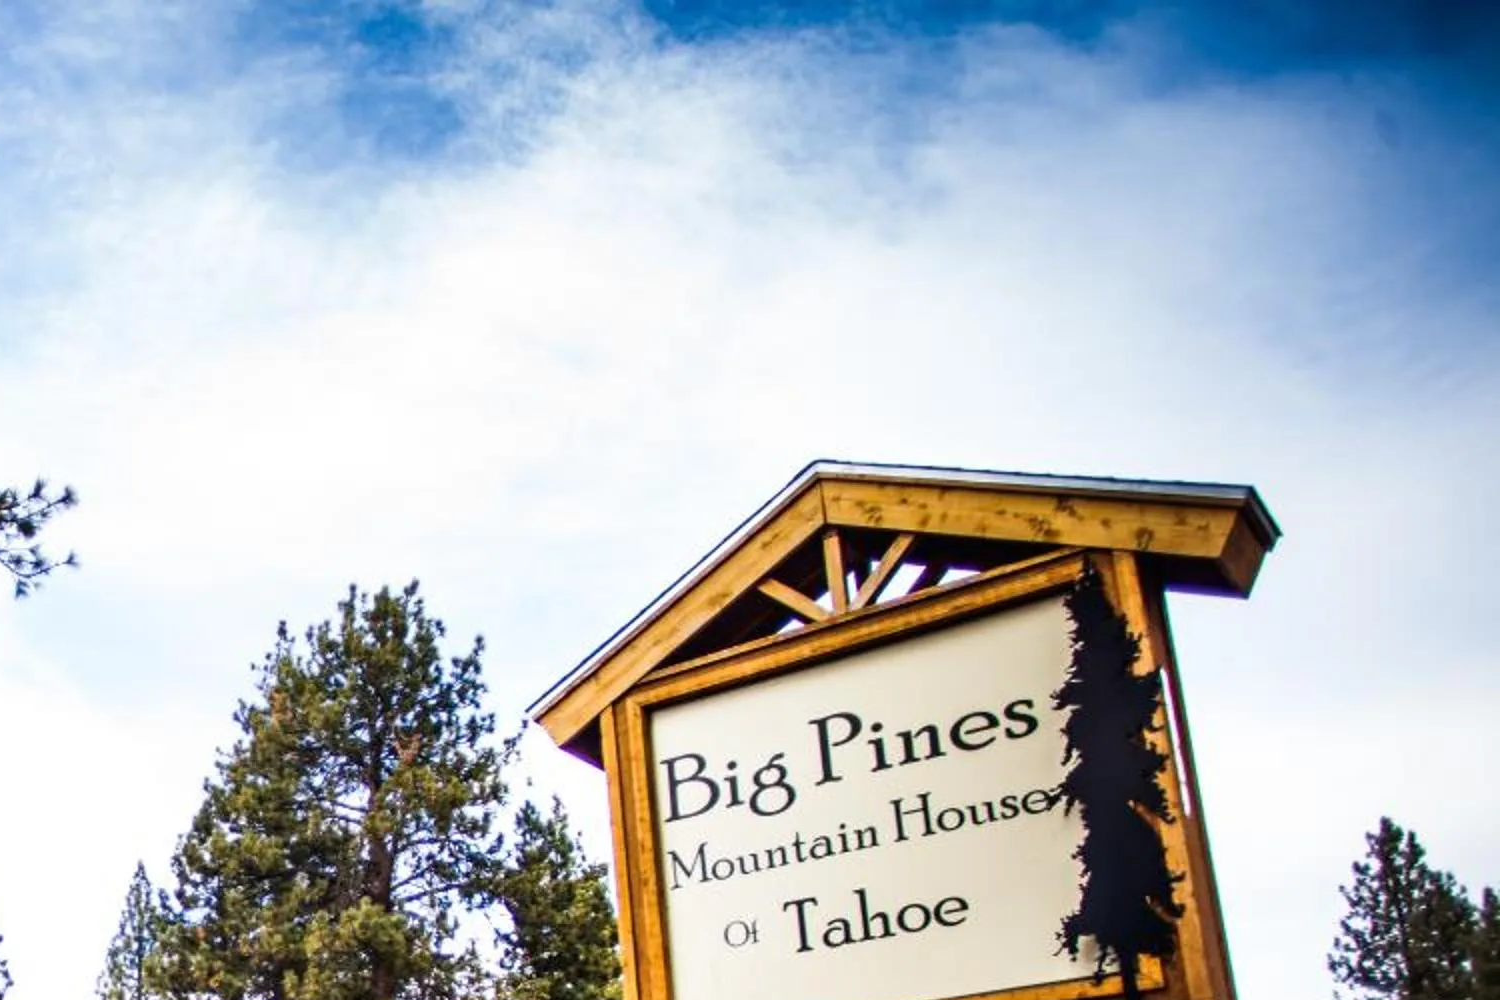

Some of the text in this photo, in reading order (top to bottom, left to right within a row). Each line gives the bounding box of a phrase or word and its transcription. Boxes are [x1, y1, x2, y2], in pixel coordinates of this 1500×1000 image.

[660, 699, 1039, 823] Big Pines
[667, 791, 1050, 890] Mountain House
[723, 888, 969, 953] Of Tahoe
